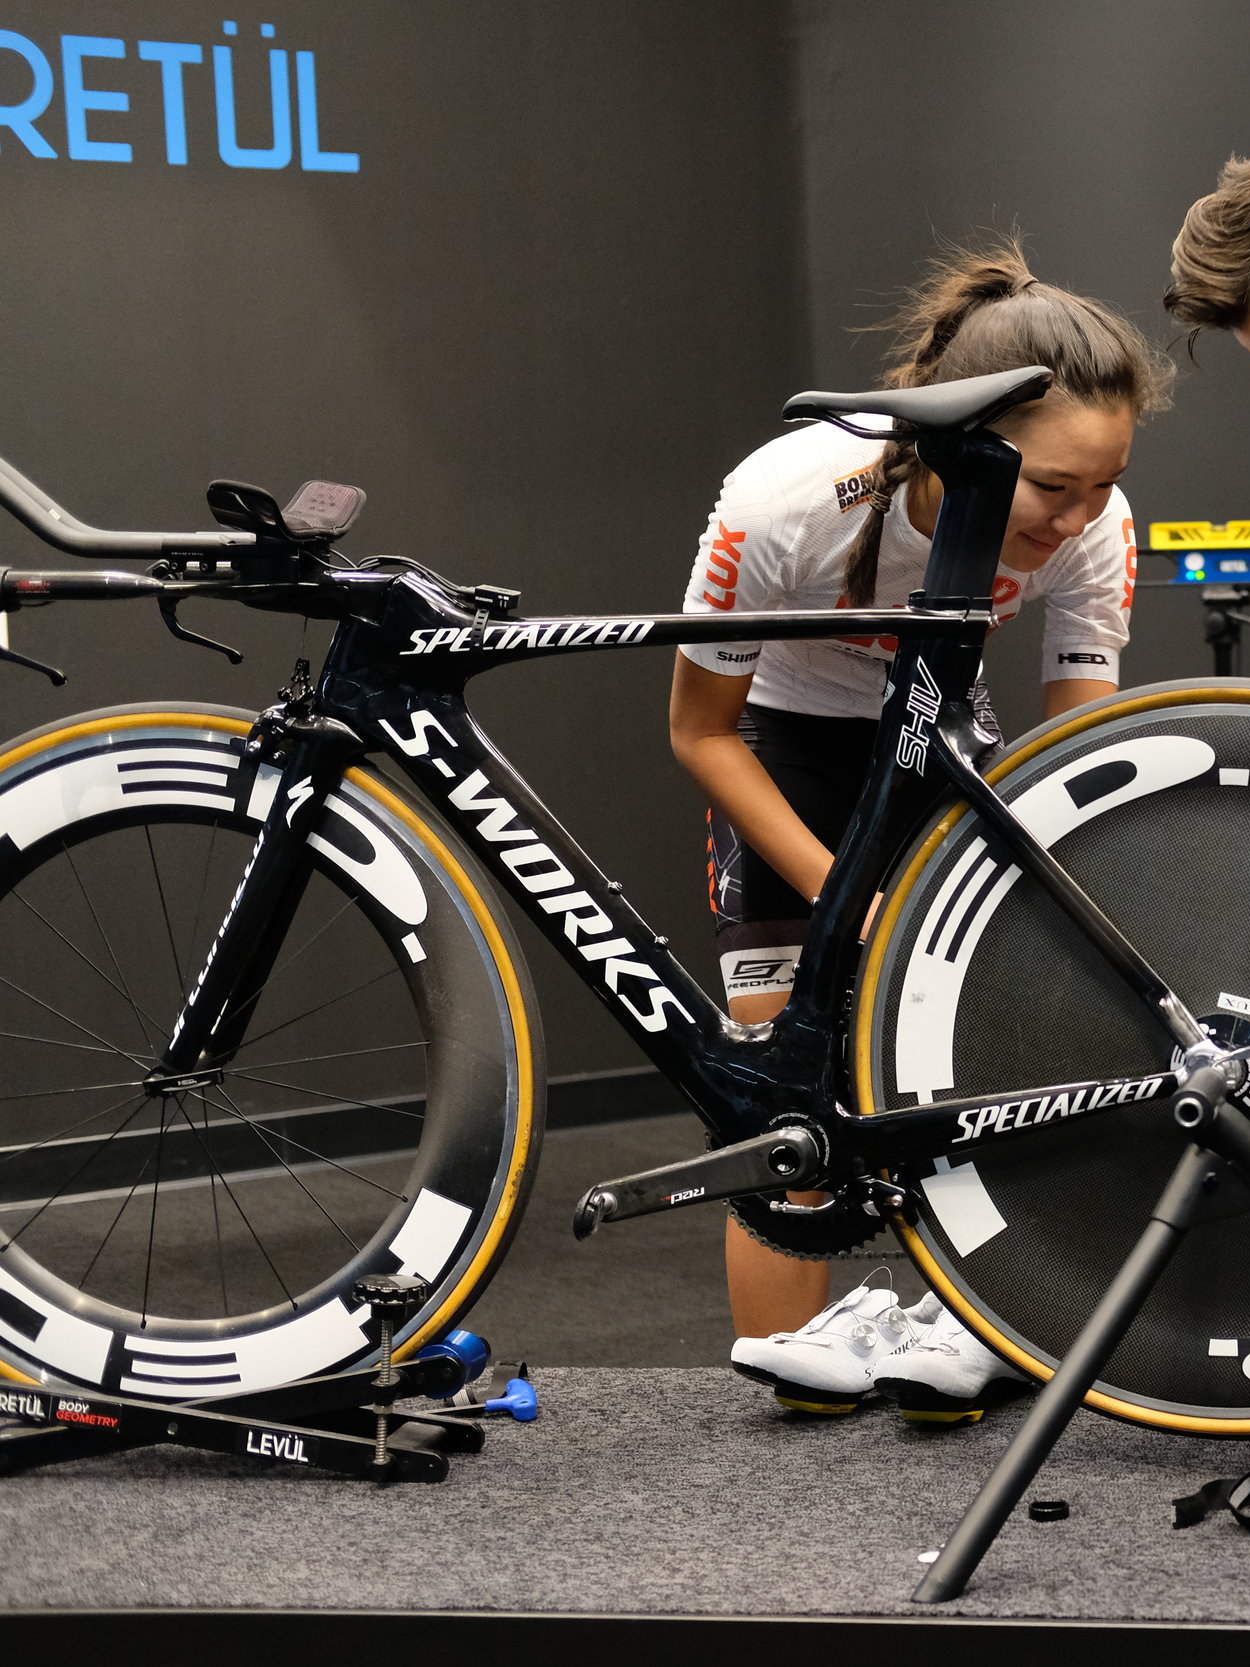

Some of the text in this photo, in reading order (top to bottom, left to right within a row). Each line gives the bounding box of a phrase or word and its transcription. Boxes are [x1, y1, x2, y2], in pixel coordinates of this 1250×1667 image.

[0, 20, 361, 174] RETÜL
[703, 519, 747, 611] LUX
[399, 620, 656, 656] SPECIALIZED
[895, 655, 943, 778] SHIV
[378, 709, 697, 1033] S-WORKS
[951, 1076, 1165, 1144] SPECIALIZED
[0, 1390, 46, 1418] RETÜL
[56, 1409, 119, 1428] GEOMETRY
[58, 1399, 90, 1415] BODY
[246, 1429, 310, 1464] LEVÜL
